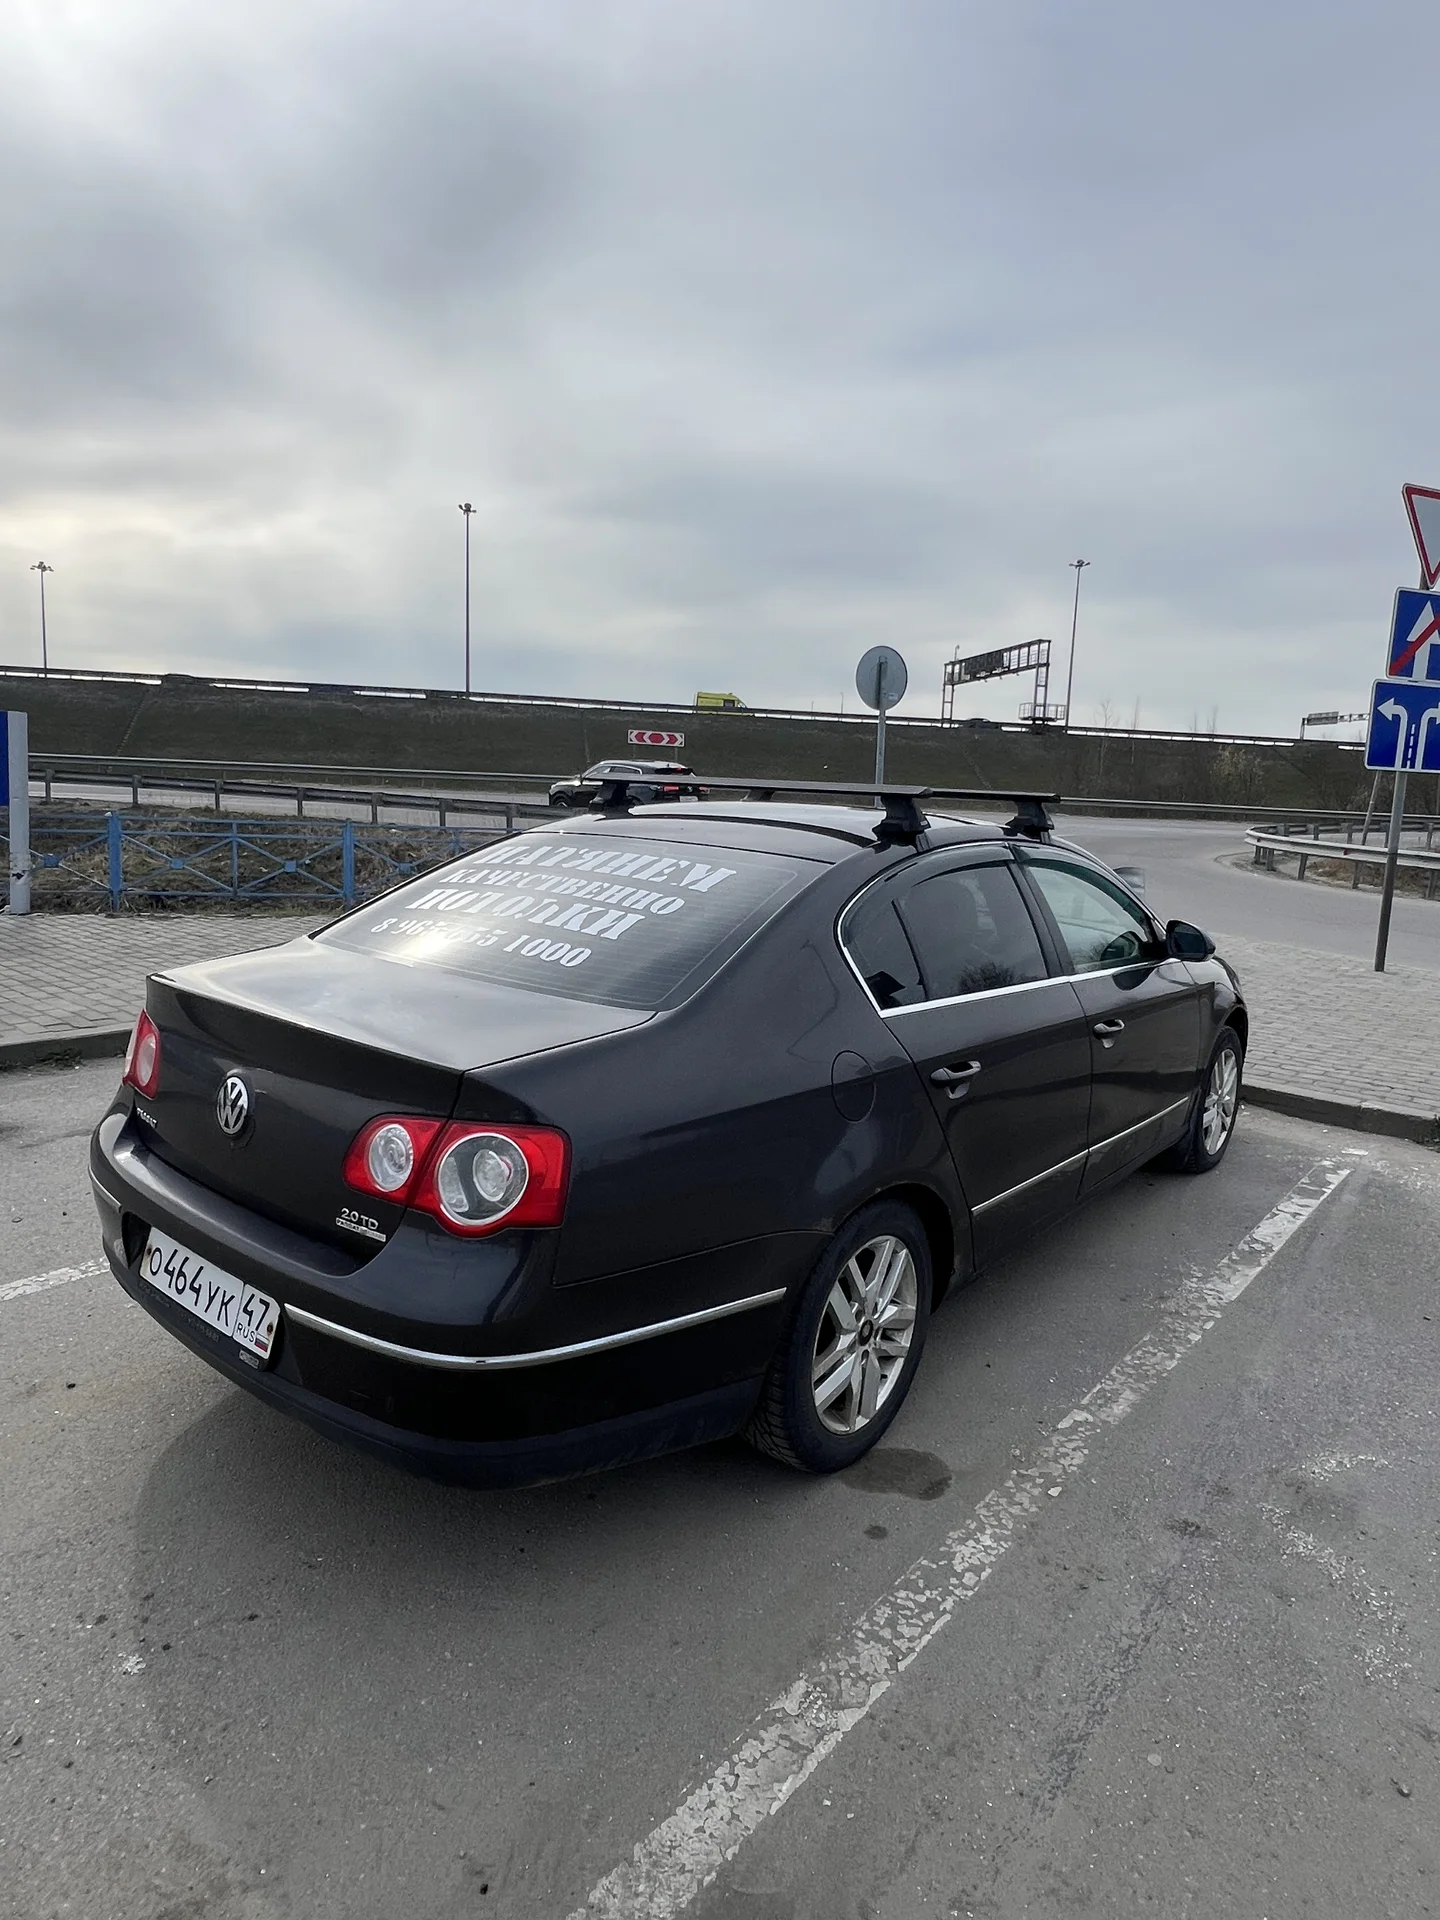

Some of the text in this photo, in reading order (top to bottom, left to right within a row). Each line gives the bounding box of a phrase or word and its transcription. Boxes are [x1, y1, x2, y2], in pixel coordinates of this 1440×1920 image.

[439, 868, 685, 915] КАЧЕСТВЕННО
[472, 846, 737, 893] НАТЯНЕМ
[404, 888, 645, 940] ПОТОЛКИ
[503, 934, 592, 967] 1000
[236, 1324, 256, 1344] RUS
